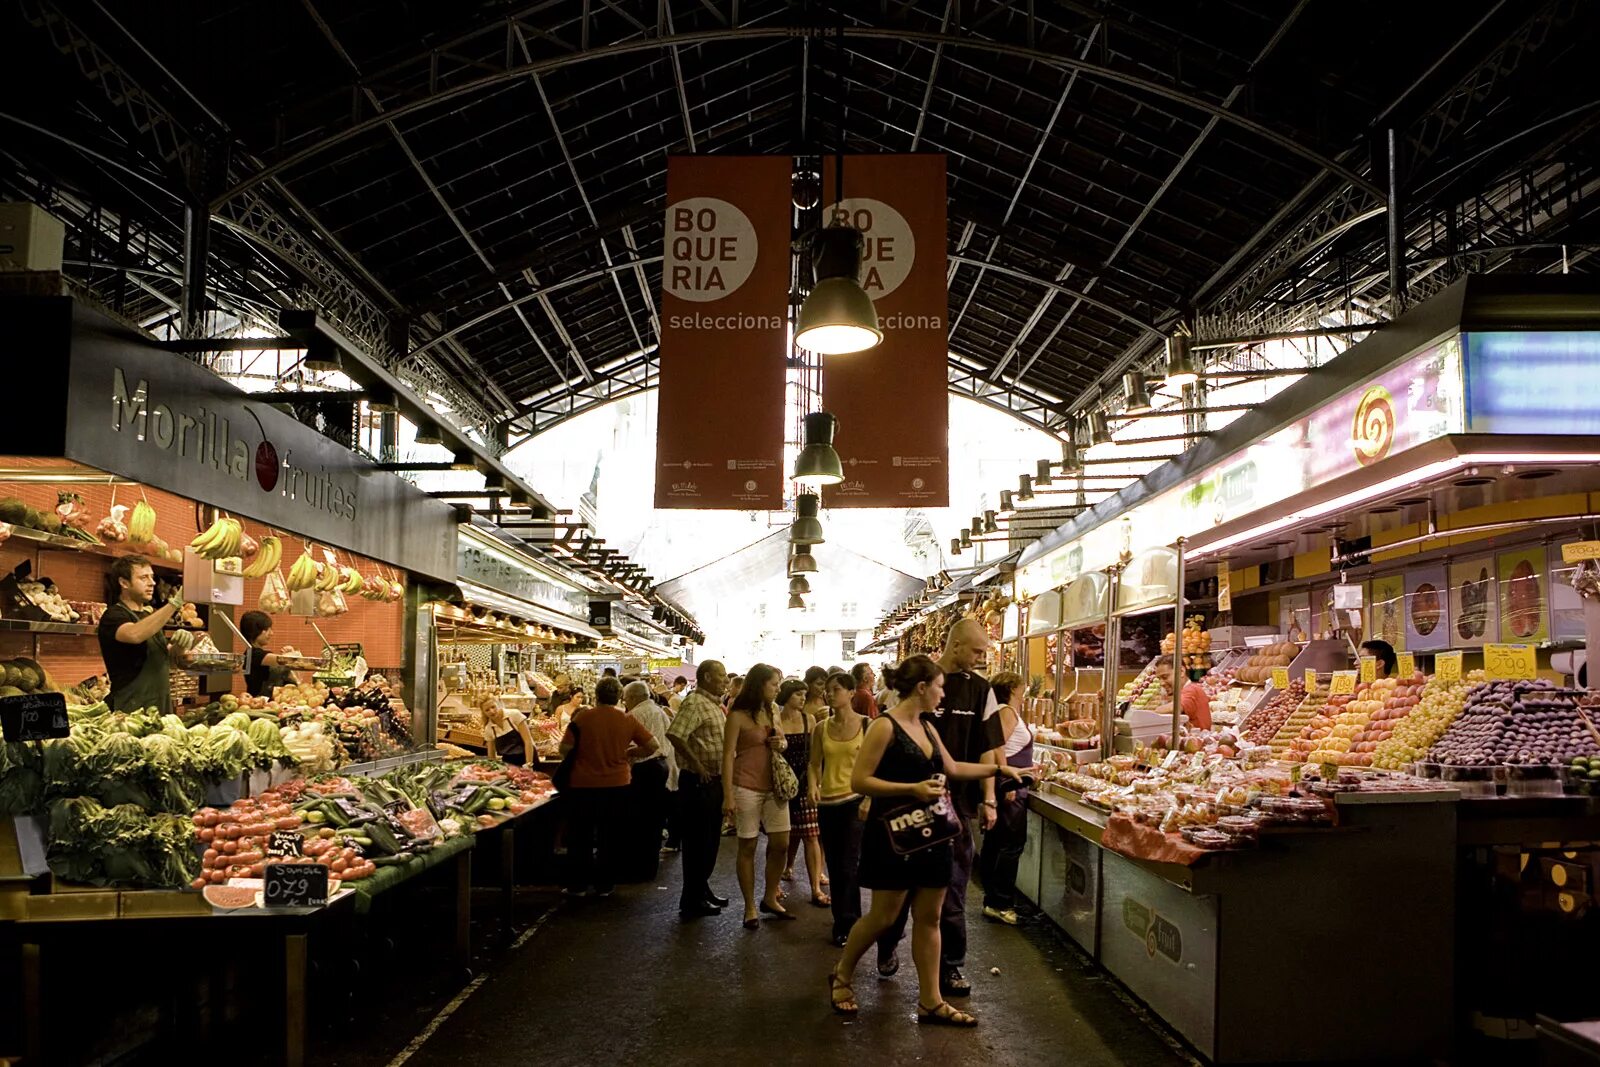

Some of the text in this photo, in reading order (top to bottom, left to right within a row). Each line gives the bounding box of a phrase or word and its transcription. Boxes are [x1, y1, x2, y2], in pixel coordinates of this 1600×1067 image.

[674, 208, 716, 232] BO
[672, 237, 737, 261] QUE
[672, 266, 725, 290] RIA
[669, 312, 781, 330] selecciona
[876, 312, 941, 329] cciona
[112, 367, 249, 481] Morilla
[282, 449, 356, 522] fruites
